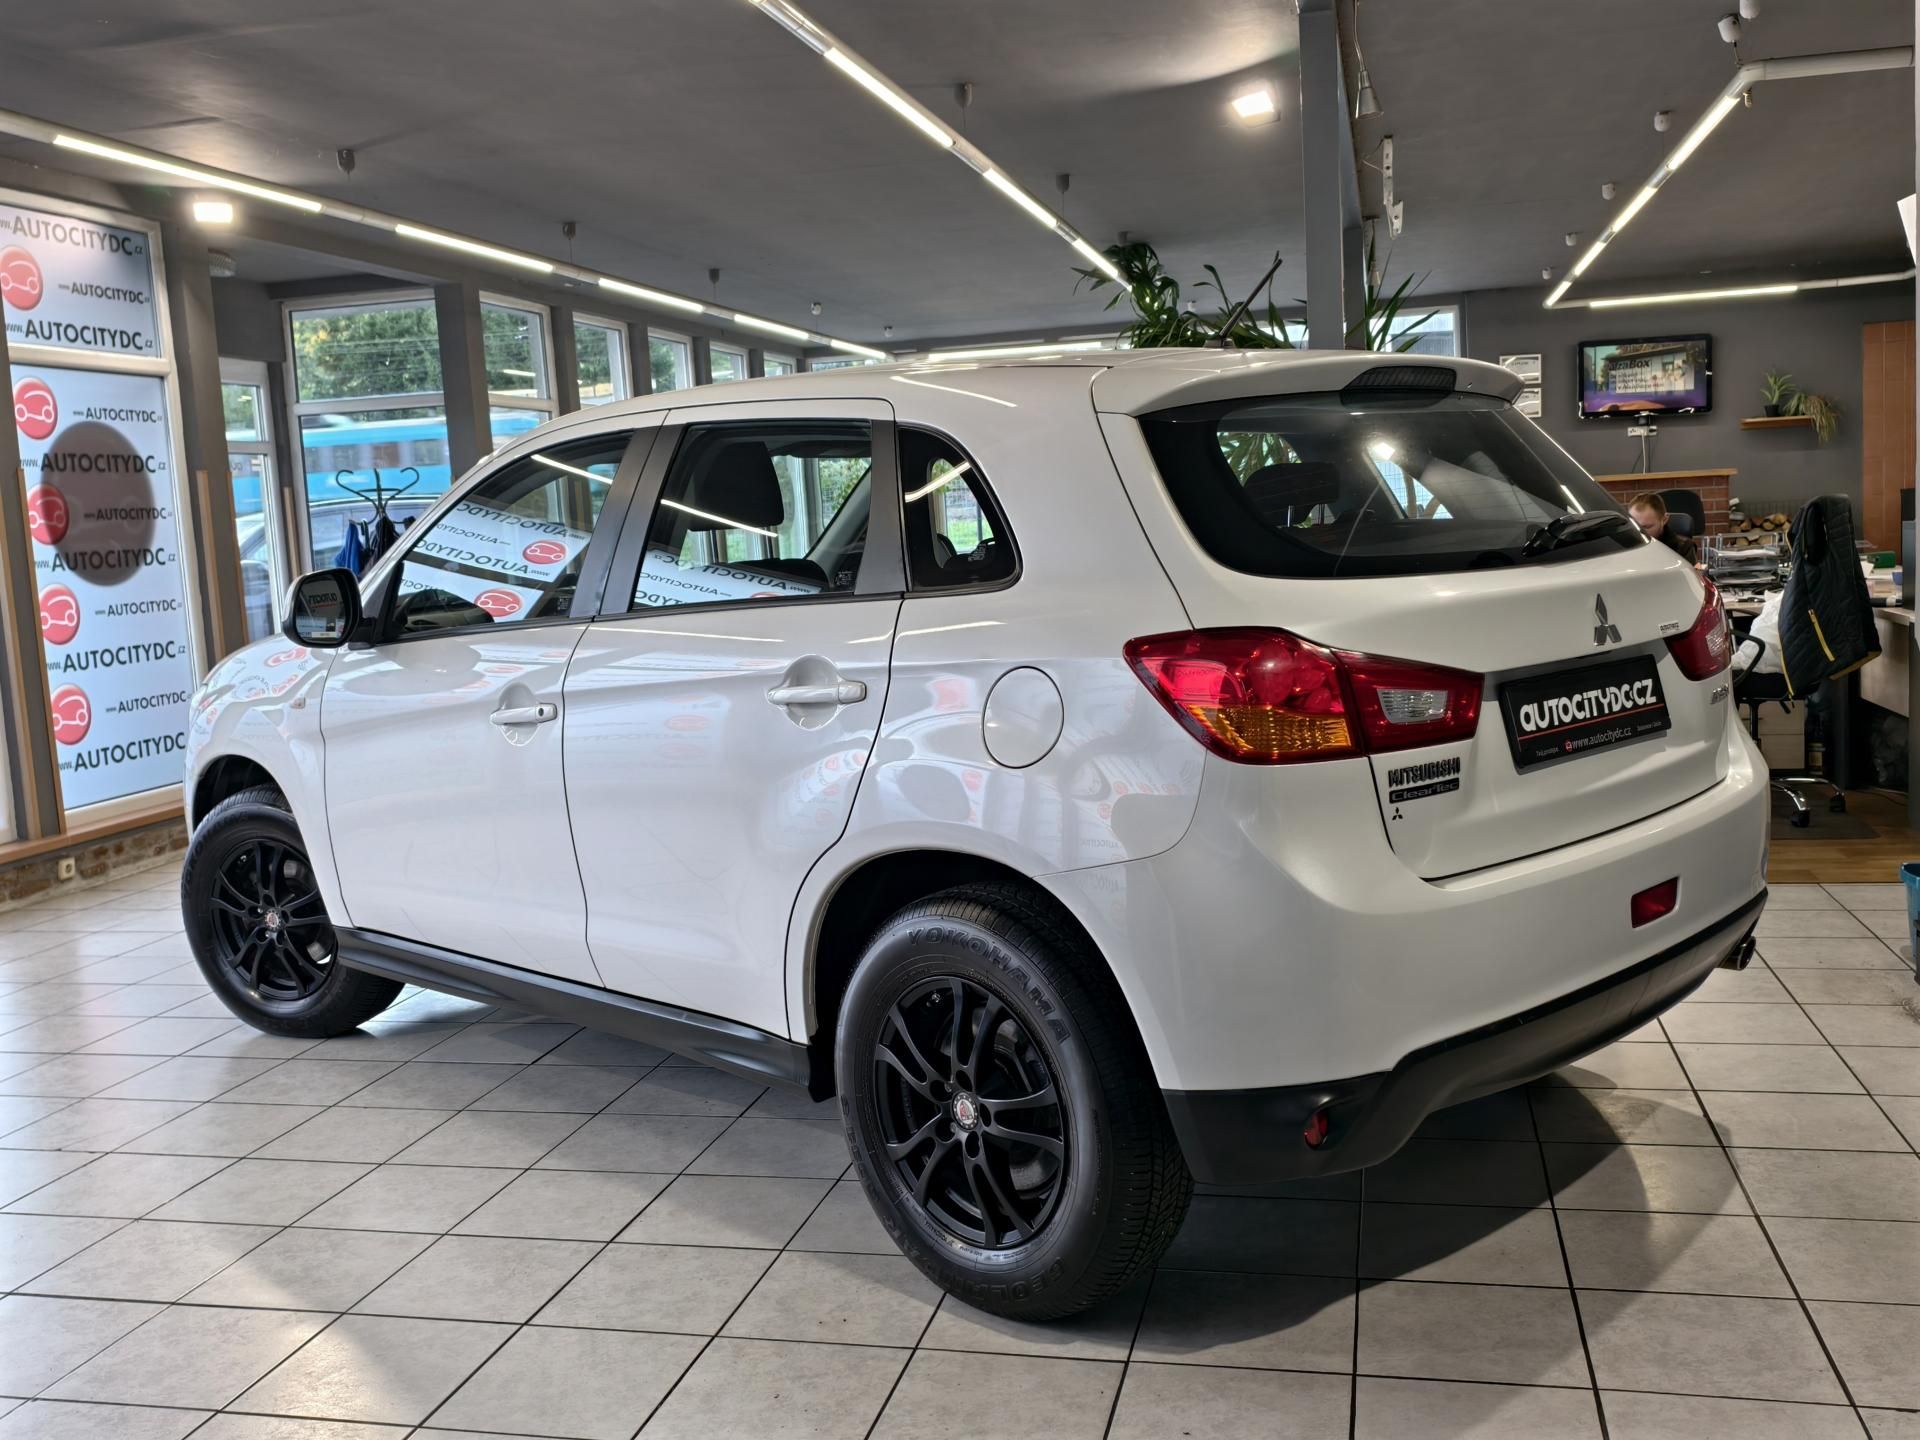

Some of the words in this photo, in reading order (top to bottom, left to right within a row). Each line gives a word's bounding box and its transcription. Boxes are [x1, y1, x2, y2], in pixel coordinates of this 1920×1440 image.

[1388, 757, 1461, 788] MITSUBISHI
[1391, 781, 1459, 801] ClearTec
[905, 926, 1071, 1043] YOKOHAMA
